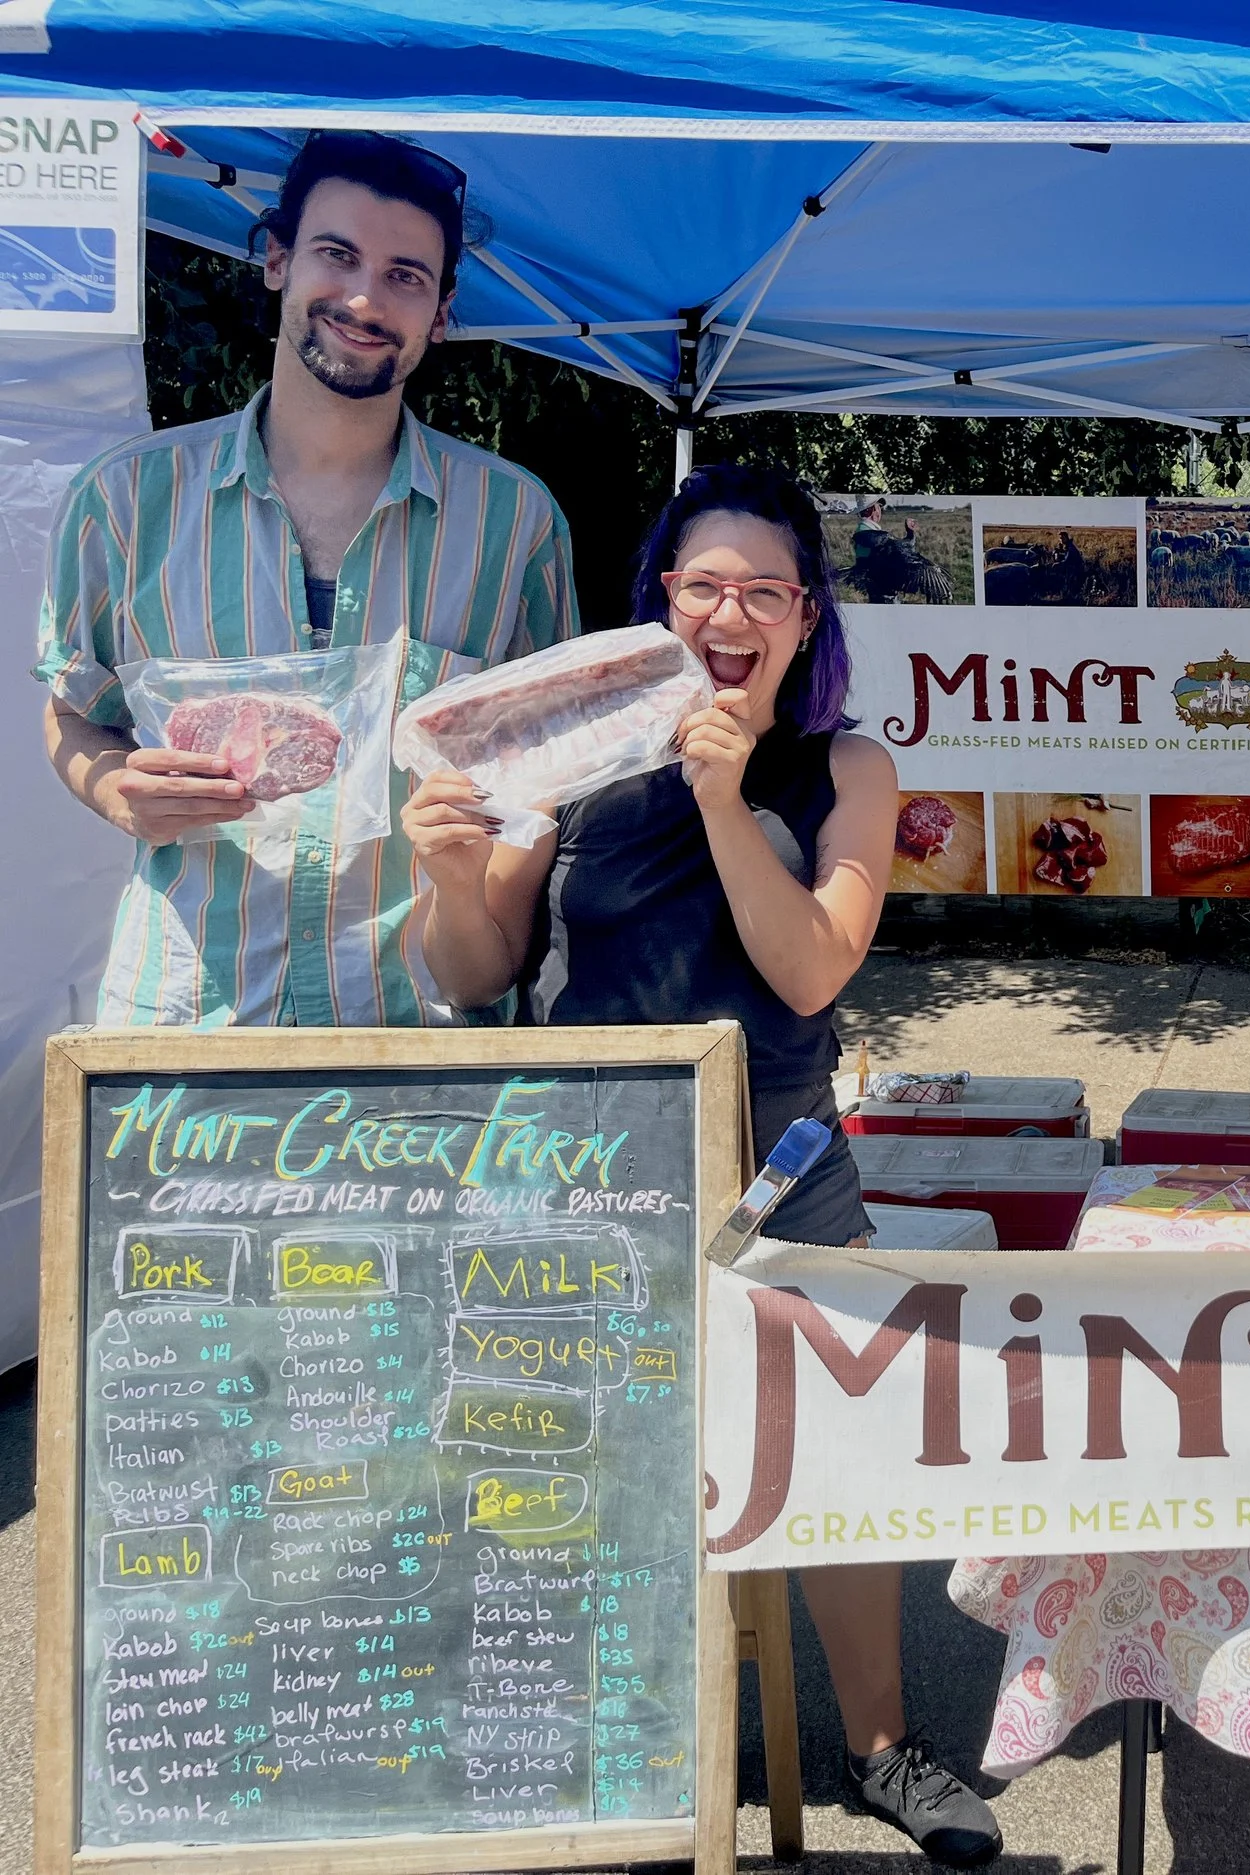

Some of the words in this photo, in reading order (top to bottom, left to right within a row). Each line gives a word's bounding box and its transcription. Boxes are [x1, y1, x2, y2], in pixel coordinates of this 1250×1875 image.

[0, 117, 119, 154] SNAP
[37, 164, 117, 190] HERE
[928, 735, 1021, 748] GRASS-FED
[1028, 736, 1082, 749] MEATS
[1088, 737, 1149, 750] RAISED
[1155, 738, 1180, 750] ON
[275, 1089, 463, 1181] CREEK
[459, 1075, 630, 1188] FARM
[318, 1181, 400, 1213] MEAT
[406, 1186, 444, 1214] ON
[455, 1187, 554, 1215] ORGANIC
[567, 1186, 673, 1215] PASTURES
[129, 1242, 213, 1288] Pork
[102, 1308, 193, 1344] ground
[277, 1304, 356, 1333] ground
[366, 1301, 396, 1317] $13
[370, 1322, 399, 1337] $15
[279, 1355, 364, 1378] Chorizo
[376, 1354, 403, 1370] $14
[101, 1379, 205, 1400] Chorizo
[105, 1409, 200, 1443] patties
[220, 1407, 253, 1428] $13
[290, 1407, 396, 1431] Shoulder
[316, 1424, 389, 1450] Roast
[109, 1443, 185, 1469] Italian
[229, 1484, 262, 1503] $13
[279, 1465, 352, 1498] Goat
[475, 1477, 567, 1517] Beef
[334, 1509, 392, 1529] chop
[785, 1503, 1047, 1546] GRASS-FED
[1069, 1498, 1215, 1533] MEATS
[118, 1536, 200, 1575] Lamb
[330, 1535, 373, 1553] ribs
[272, 1565, 320, 1587] neck
[336, 1562, 387, 1584] chop
[477, 1546, 569, 1576] ground
[103, 1602, 177, 1640] ground
[321, 1611, 384, 1628] bones
[272, 1643, 335, 1663] liver
[355, 1635, 394, 1654] $14
[472, 1628, 519, 1649] beef
[526, 1628, 574, 1646] stew
[600, 1648, 633, 1666] $35
[272, 1669, 341, 1693] kidney
[357, 1664, 397, 1684] $14
[106, 1701, 145, 1726] loin
[157, 1697, 208, 1717] chop
[217, 1692, 249, 1709] $24
[271, 1701, 319, 1729] belly
[327, 1694, 373, 1720] meat
[379, 1689, 415, 1711] $28
[183, 1723, 226, 1748] rack
[234, 1724, 267, 1744] $42
[467, 1724, 500, 1748] NY
[504, 1725, 560, 1751] strip
[108, 1764, 149, 1796] leg
[158, 1758, 219, 1784] steak
